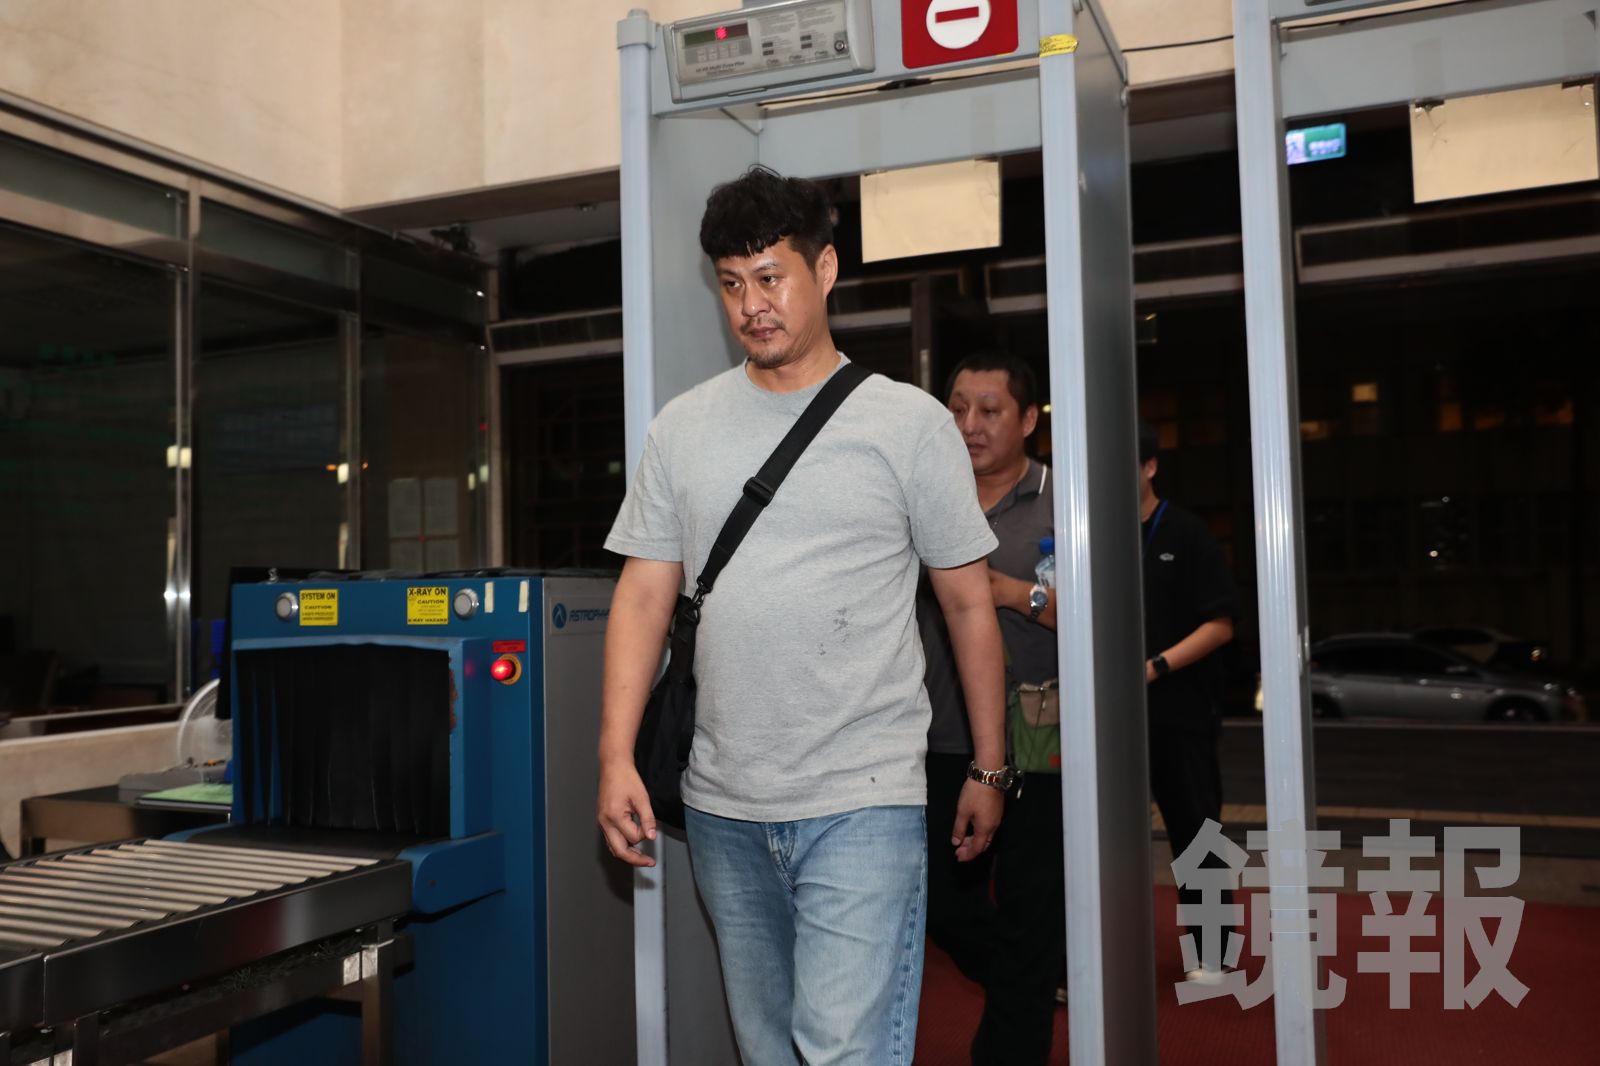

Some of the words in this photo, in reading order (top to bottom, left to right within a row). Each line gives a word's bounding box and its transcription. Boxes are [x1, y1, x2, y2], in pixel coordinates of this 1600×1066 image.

[301, 592, 325, 601] SYSTEM
[326, 592, 336, 601] ON
[408, 587, 432, 597] X-RAY
[434, 587, 447, 597] ON
